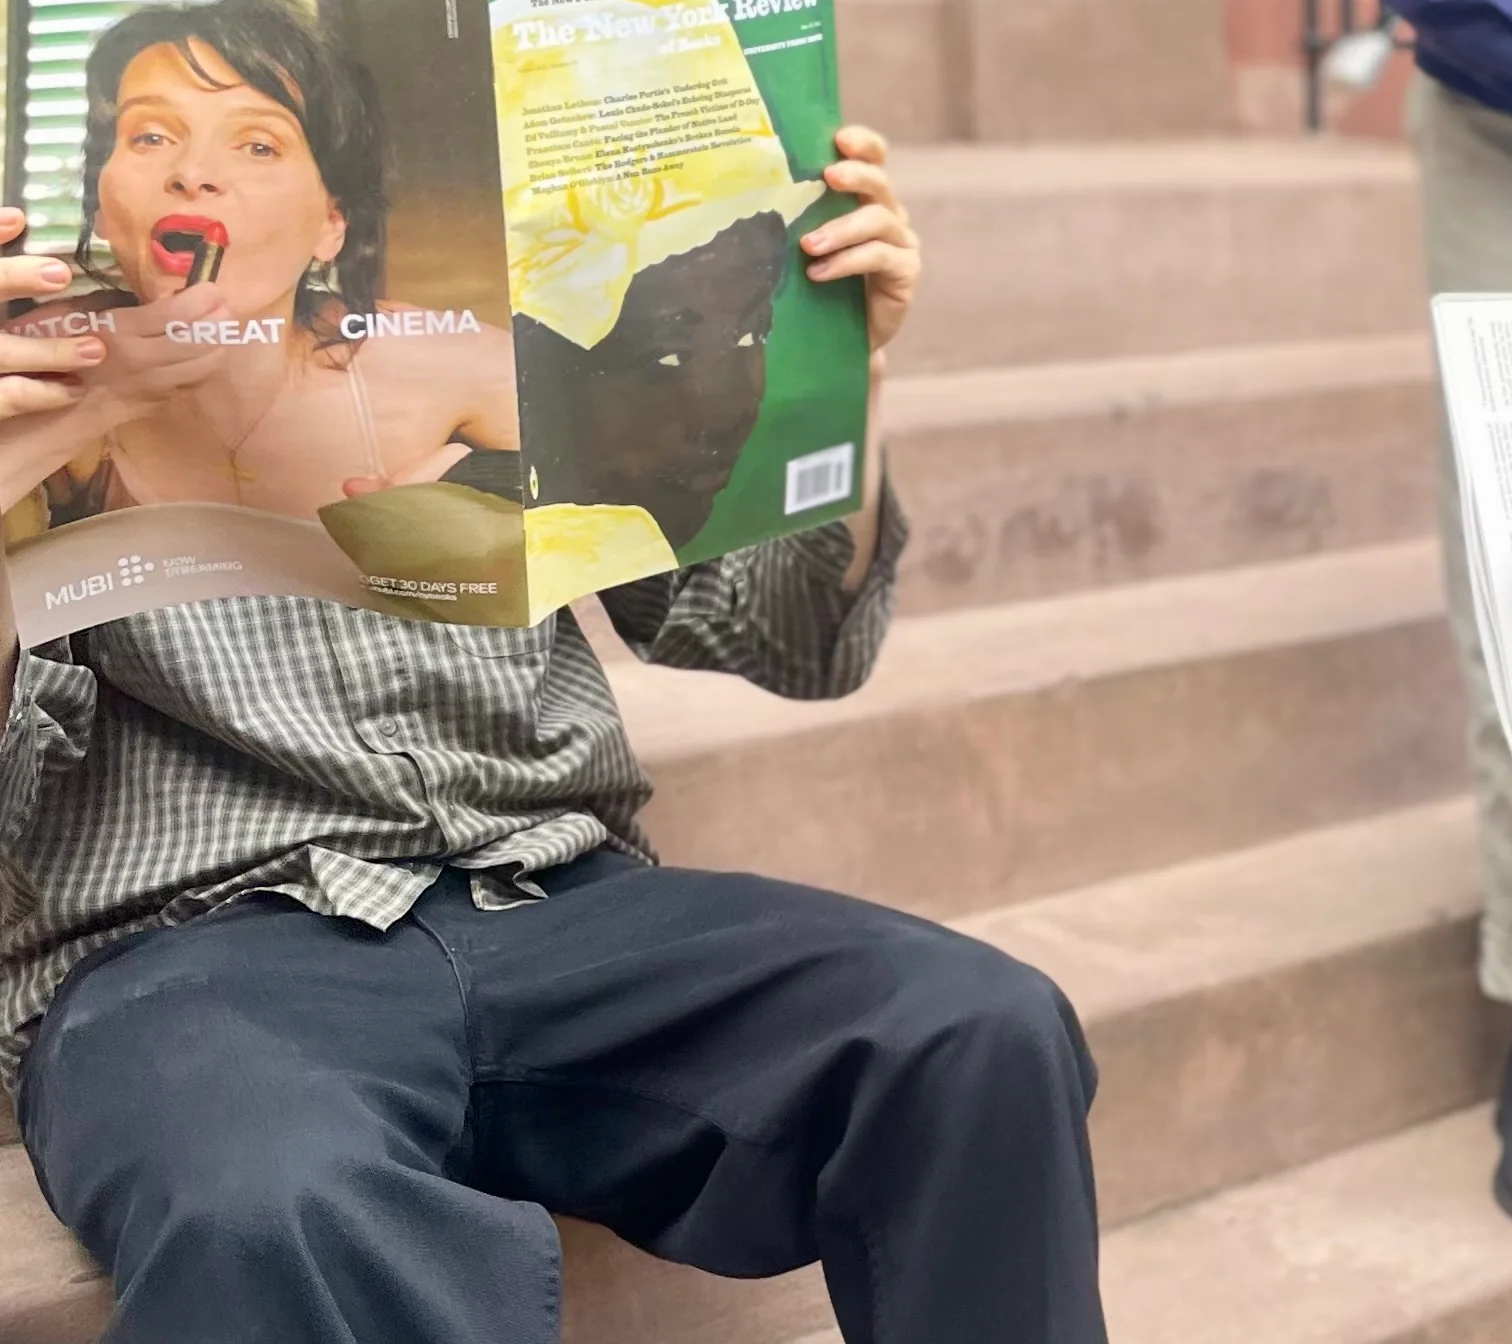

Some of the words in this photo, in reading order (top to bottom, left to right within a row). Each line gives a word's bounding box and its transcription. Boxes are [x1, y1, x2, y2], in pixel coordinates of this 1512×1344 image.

[512, 18, 575, 52] The
[582, 8, 655, 44] New
[659, 38, 678, 55] of
[678, 34, 721, 52] Books
[522, 103, 562, 115] Jonathan
[604, 92, 636, 103] Charles
[673, 80, 710, 93] Underdog
[599, 107, 623, 117] Louis
[682, 92, 712, 105] Echoing
[655, 112, 669, 120] The
[671, 107, 697, 118] French
[700, 102, 727, 113] Victims
[738, 97, 759, 108] D-Day
[526, 142, 570, 154] Francisco
[604, 132, 633, 144] Facing
[635, 129, 647, 137] the
[649, 123, 679, 134] Plunder
[691, 117, 715, 127] Native
[718, 113, 737, 122] Land
[595, 147, 620, 157] Elena
[685, 130, 712, 141] Broken
[714, 125, 739, 135] Russia
[530, 171, 555, 181] Brian
[595, 161, 611, 170] The
[614, 155, 647, 168] Rodgers
[657, 144, 708, 158] Hammerstein
[710, 136, 751, 148] Revolution
[532, 182, 568, 195] Meghan
[623, 169, 639, 178] Nun
[642, 165, 661, 175] Runs
[662, 161, 684, 172] Away
[165, 318, 286, 345] GREAT
[340, 310, 481, 340] CINEMA
[45, 571, 114, 610] MUBI
[370, 575, 398, 589] GET
[399, 578, 418, 591] 30
[419, 579, 457, 595] DAYS
[459, 580, 498, 595] FREE
